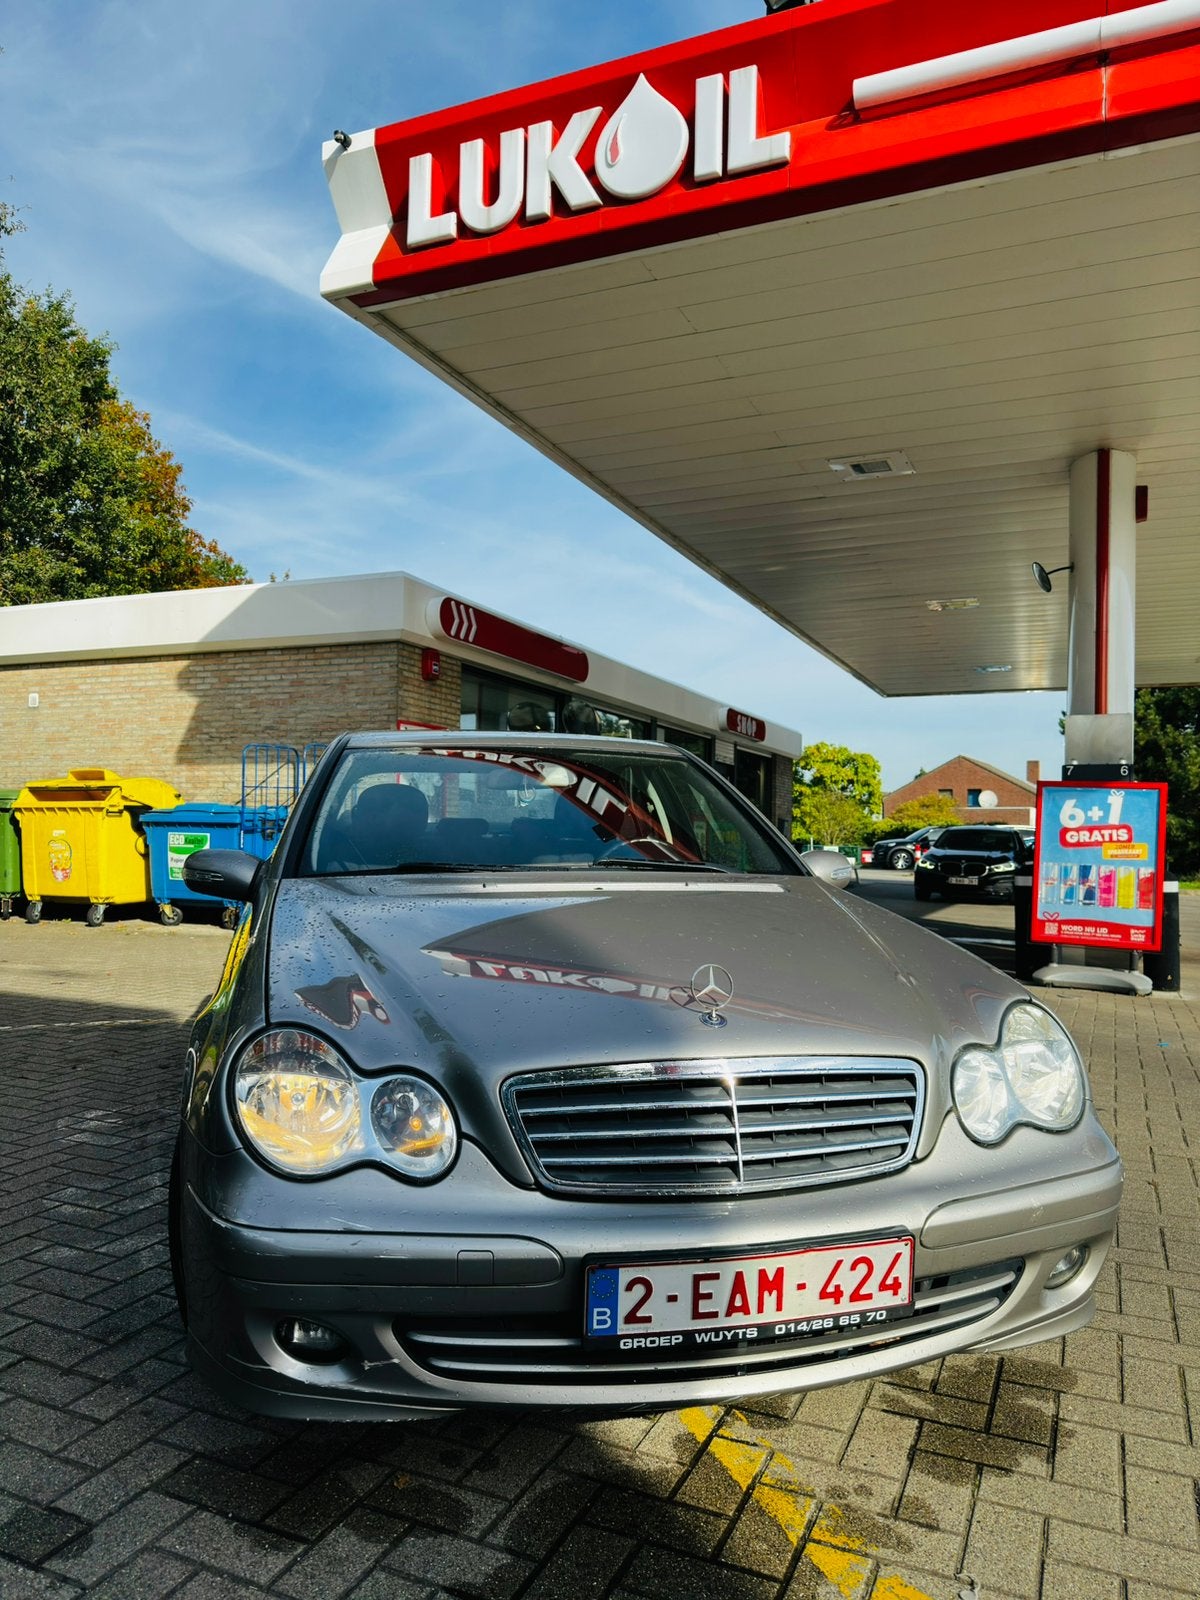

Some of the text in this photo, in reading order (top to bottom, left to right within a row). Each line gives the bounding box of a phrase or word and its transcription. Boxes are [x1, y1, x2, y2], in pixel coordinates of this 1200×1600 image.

[406, 64, 791, 250] LUKOIL
[736, 713, 757, 737] SHOP
[1065, 765, 1074, 776] 7
[1120, 765, 1129, 776] 6
[1059, 793, 1125, 829] 6+1
[1065, 829, 1129, 844] GRATIS
[1061, 924, 1083, 932] WORD
[592, 1307, 612, 1330] B
[619, 1334, 683, 1350] GROEP
[695, 1327, 758, 1344] WUYTS
[839, 1313, 860, 1326] 65
[866, 1309, 887, 1322] 70
